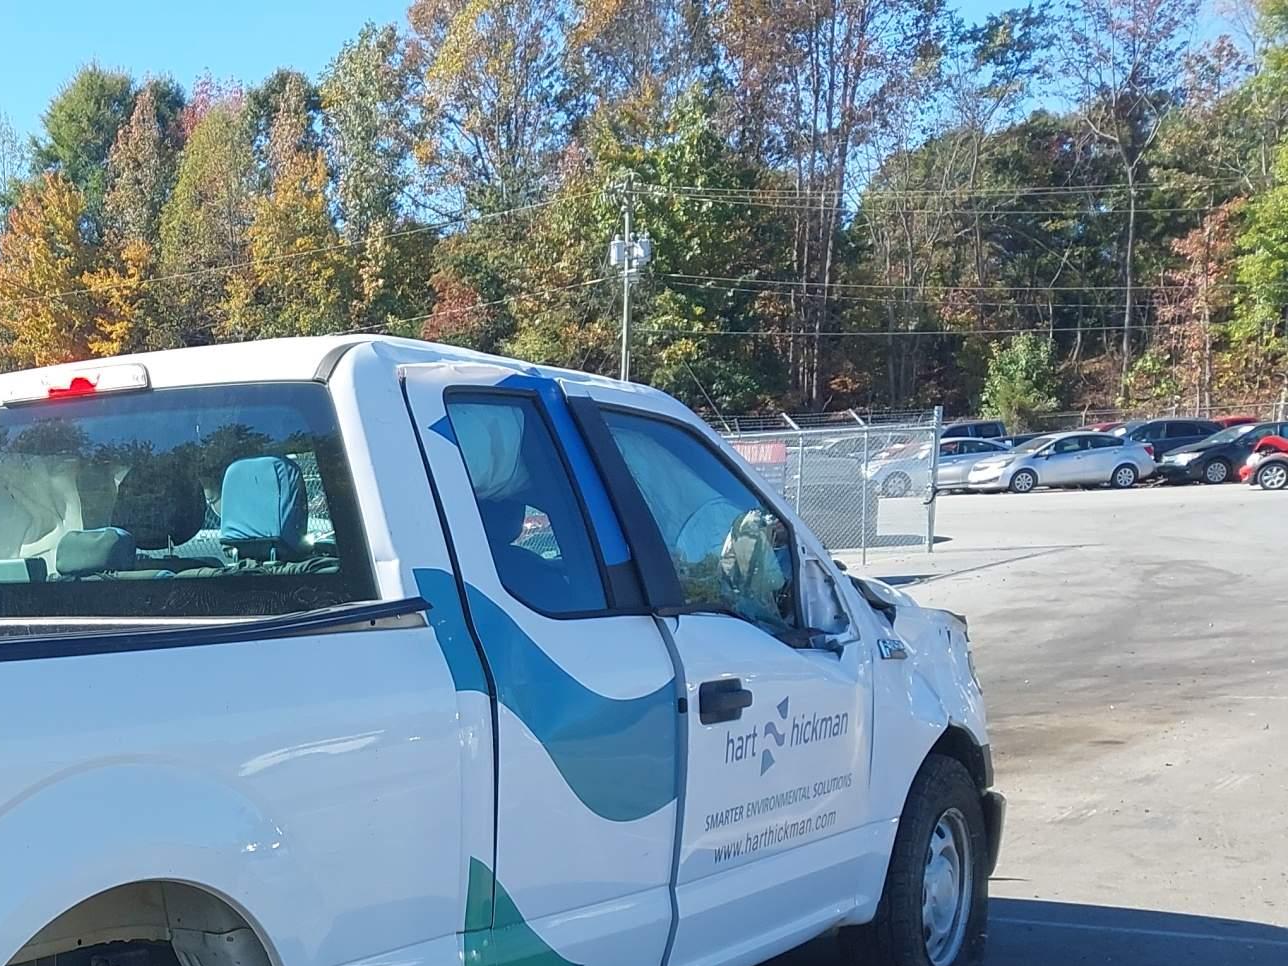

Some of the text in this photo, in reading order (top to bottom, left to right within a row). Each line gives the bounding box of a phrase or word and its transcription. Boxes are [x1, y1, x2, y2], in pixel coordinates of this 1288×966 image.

[725, 712, 849, 764] hart hickman
[705, 773, 853, 832] SMARTER ENVIRONMENTAL SOLUTIONS
[714, 810, 836, 864] www.harthickman.com
